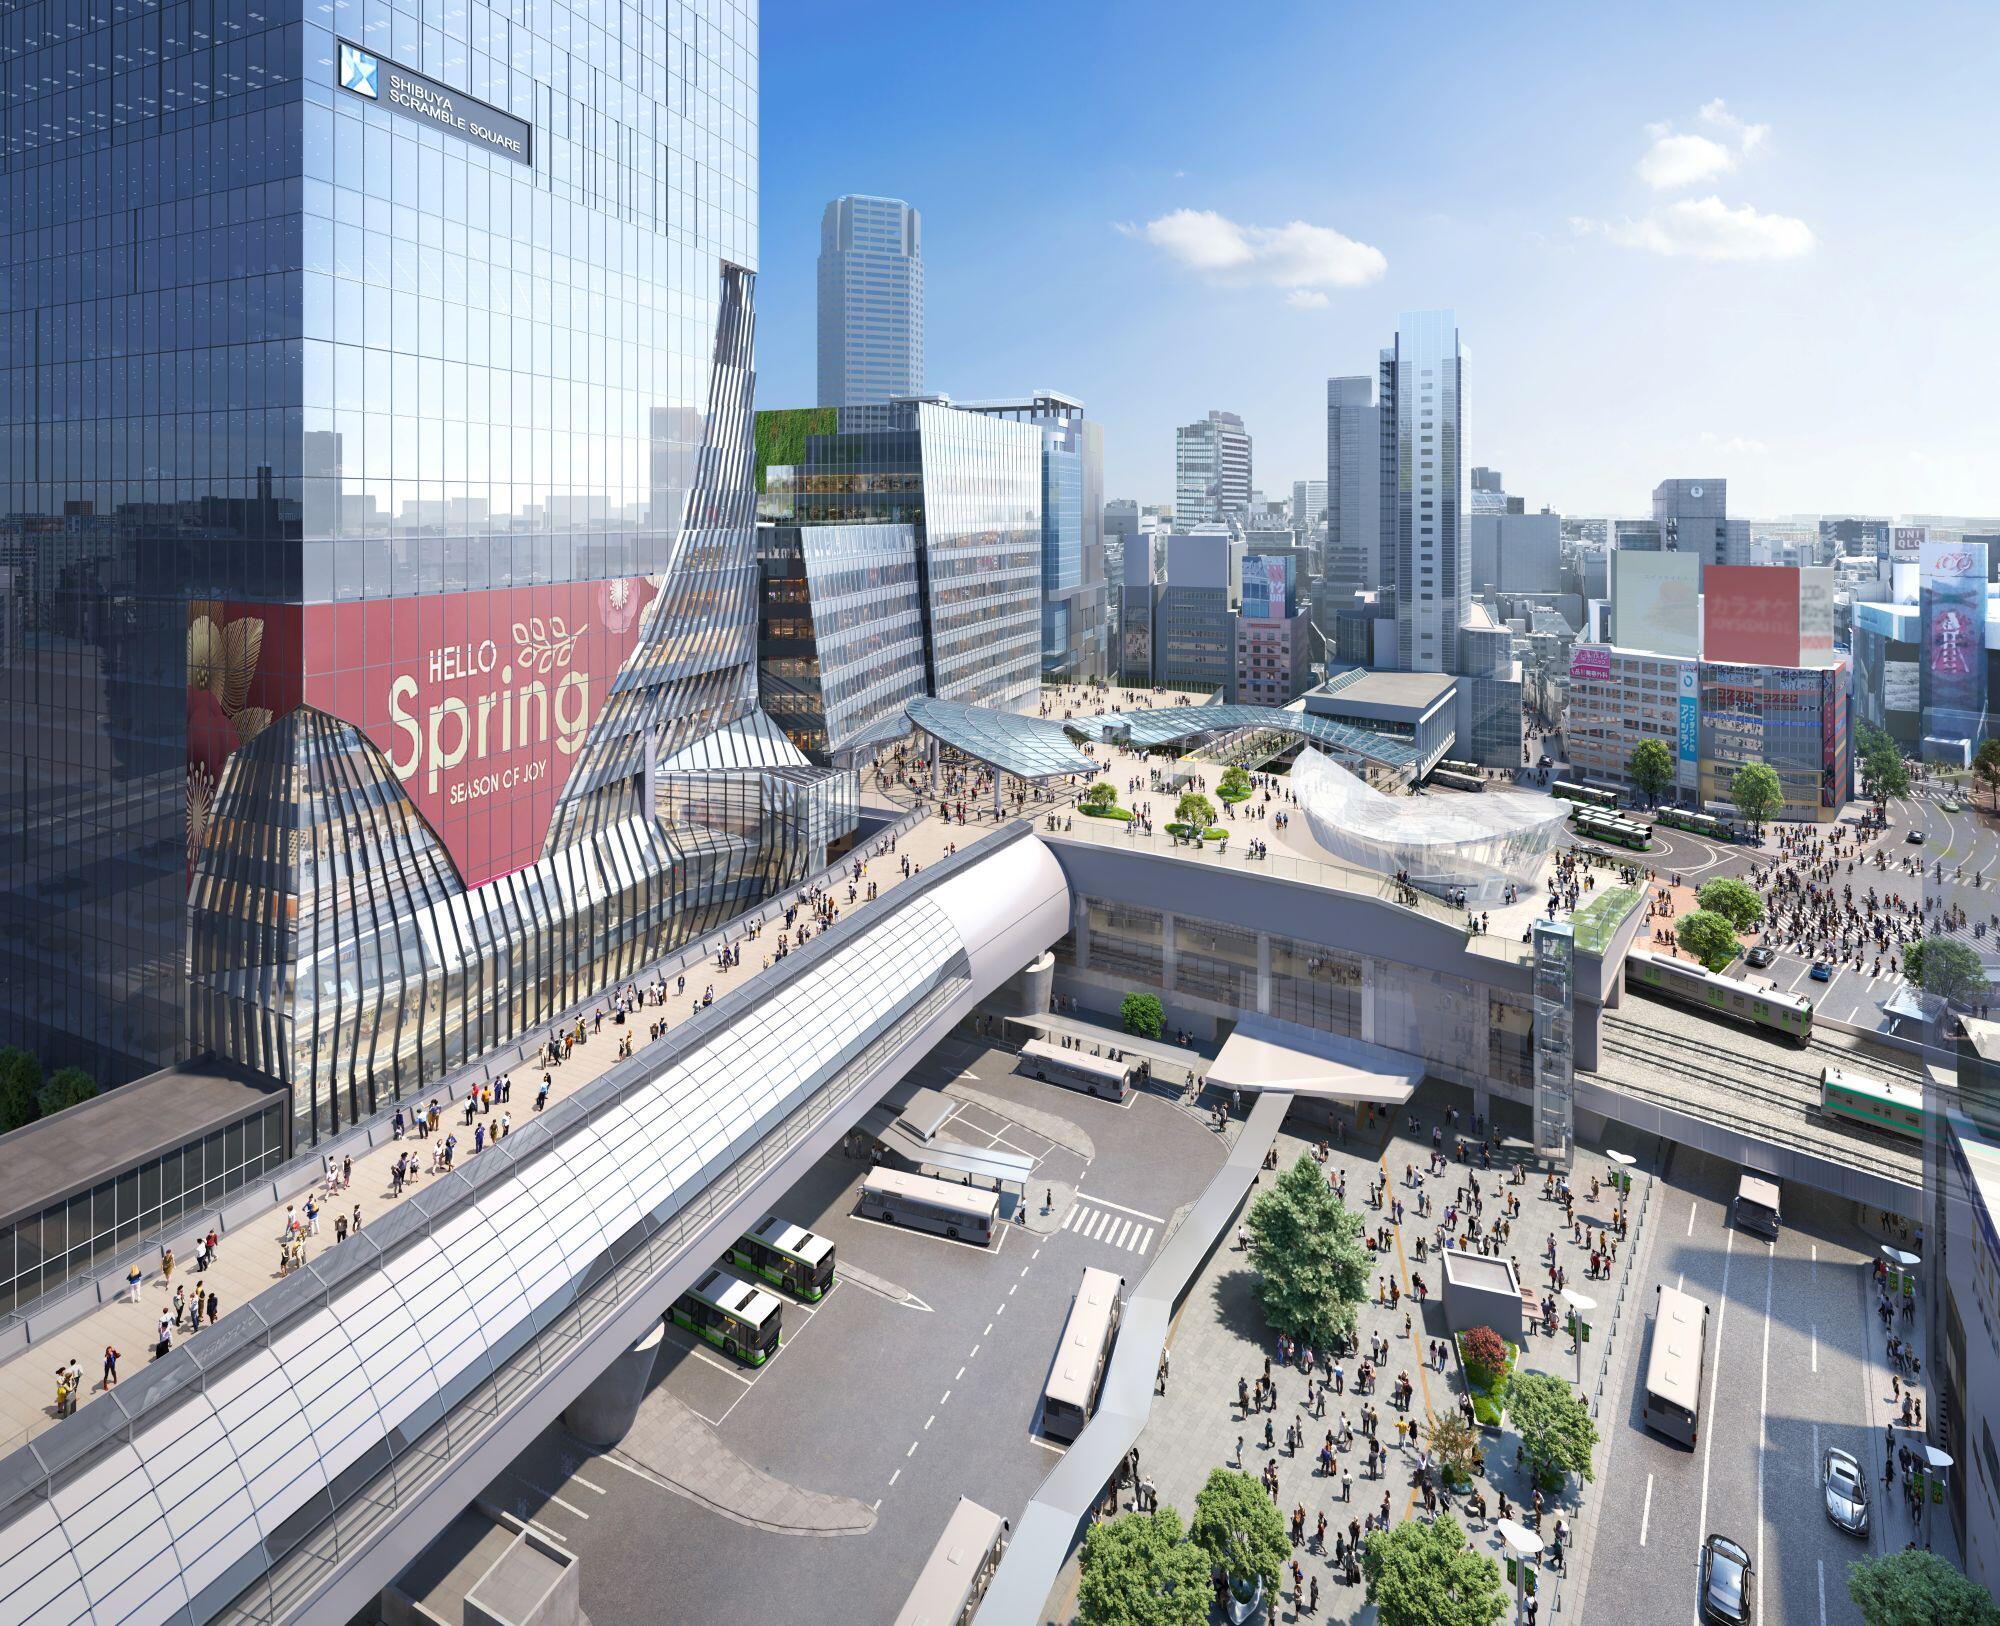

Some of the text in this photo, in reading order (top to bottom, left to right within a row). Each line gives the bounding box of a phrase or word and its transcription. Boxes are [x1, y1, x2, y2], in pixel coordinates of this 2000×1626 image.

[390, 75, 453, 112] SHIBUYA
[389, 89, 521, 154] SCRAMBLE SQUARE
[1898, 529, 1920, 538] UNI
[1711, 595, 1793, 617] カラオケ
[429, 639, 497, 683] HELLO
[384, 664, 589, 795] Spring
[1680, 703, 1689, 752] アイシティ
[450, 759, 547, 805] SEASON OF JOY
